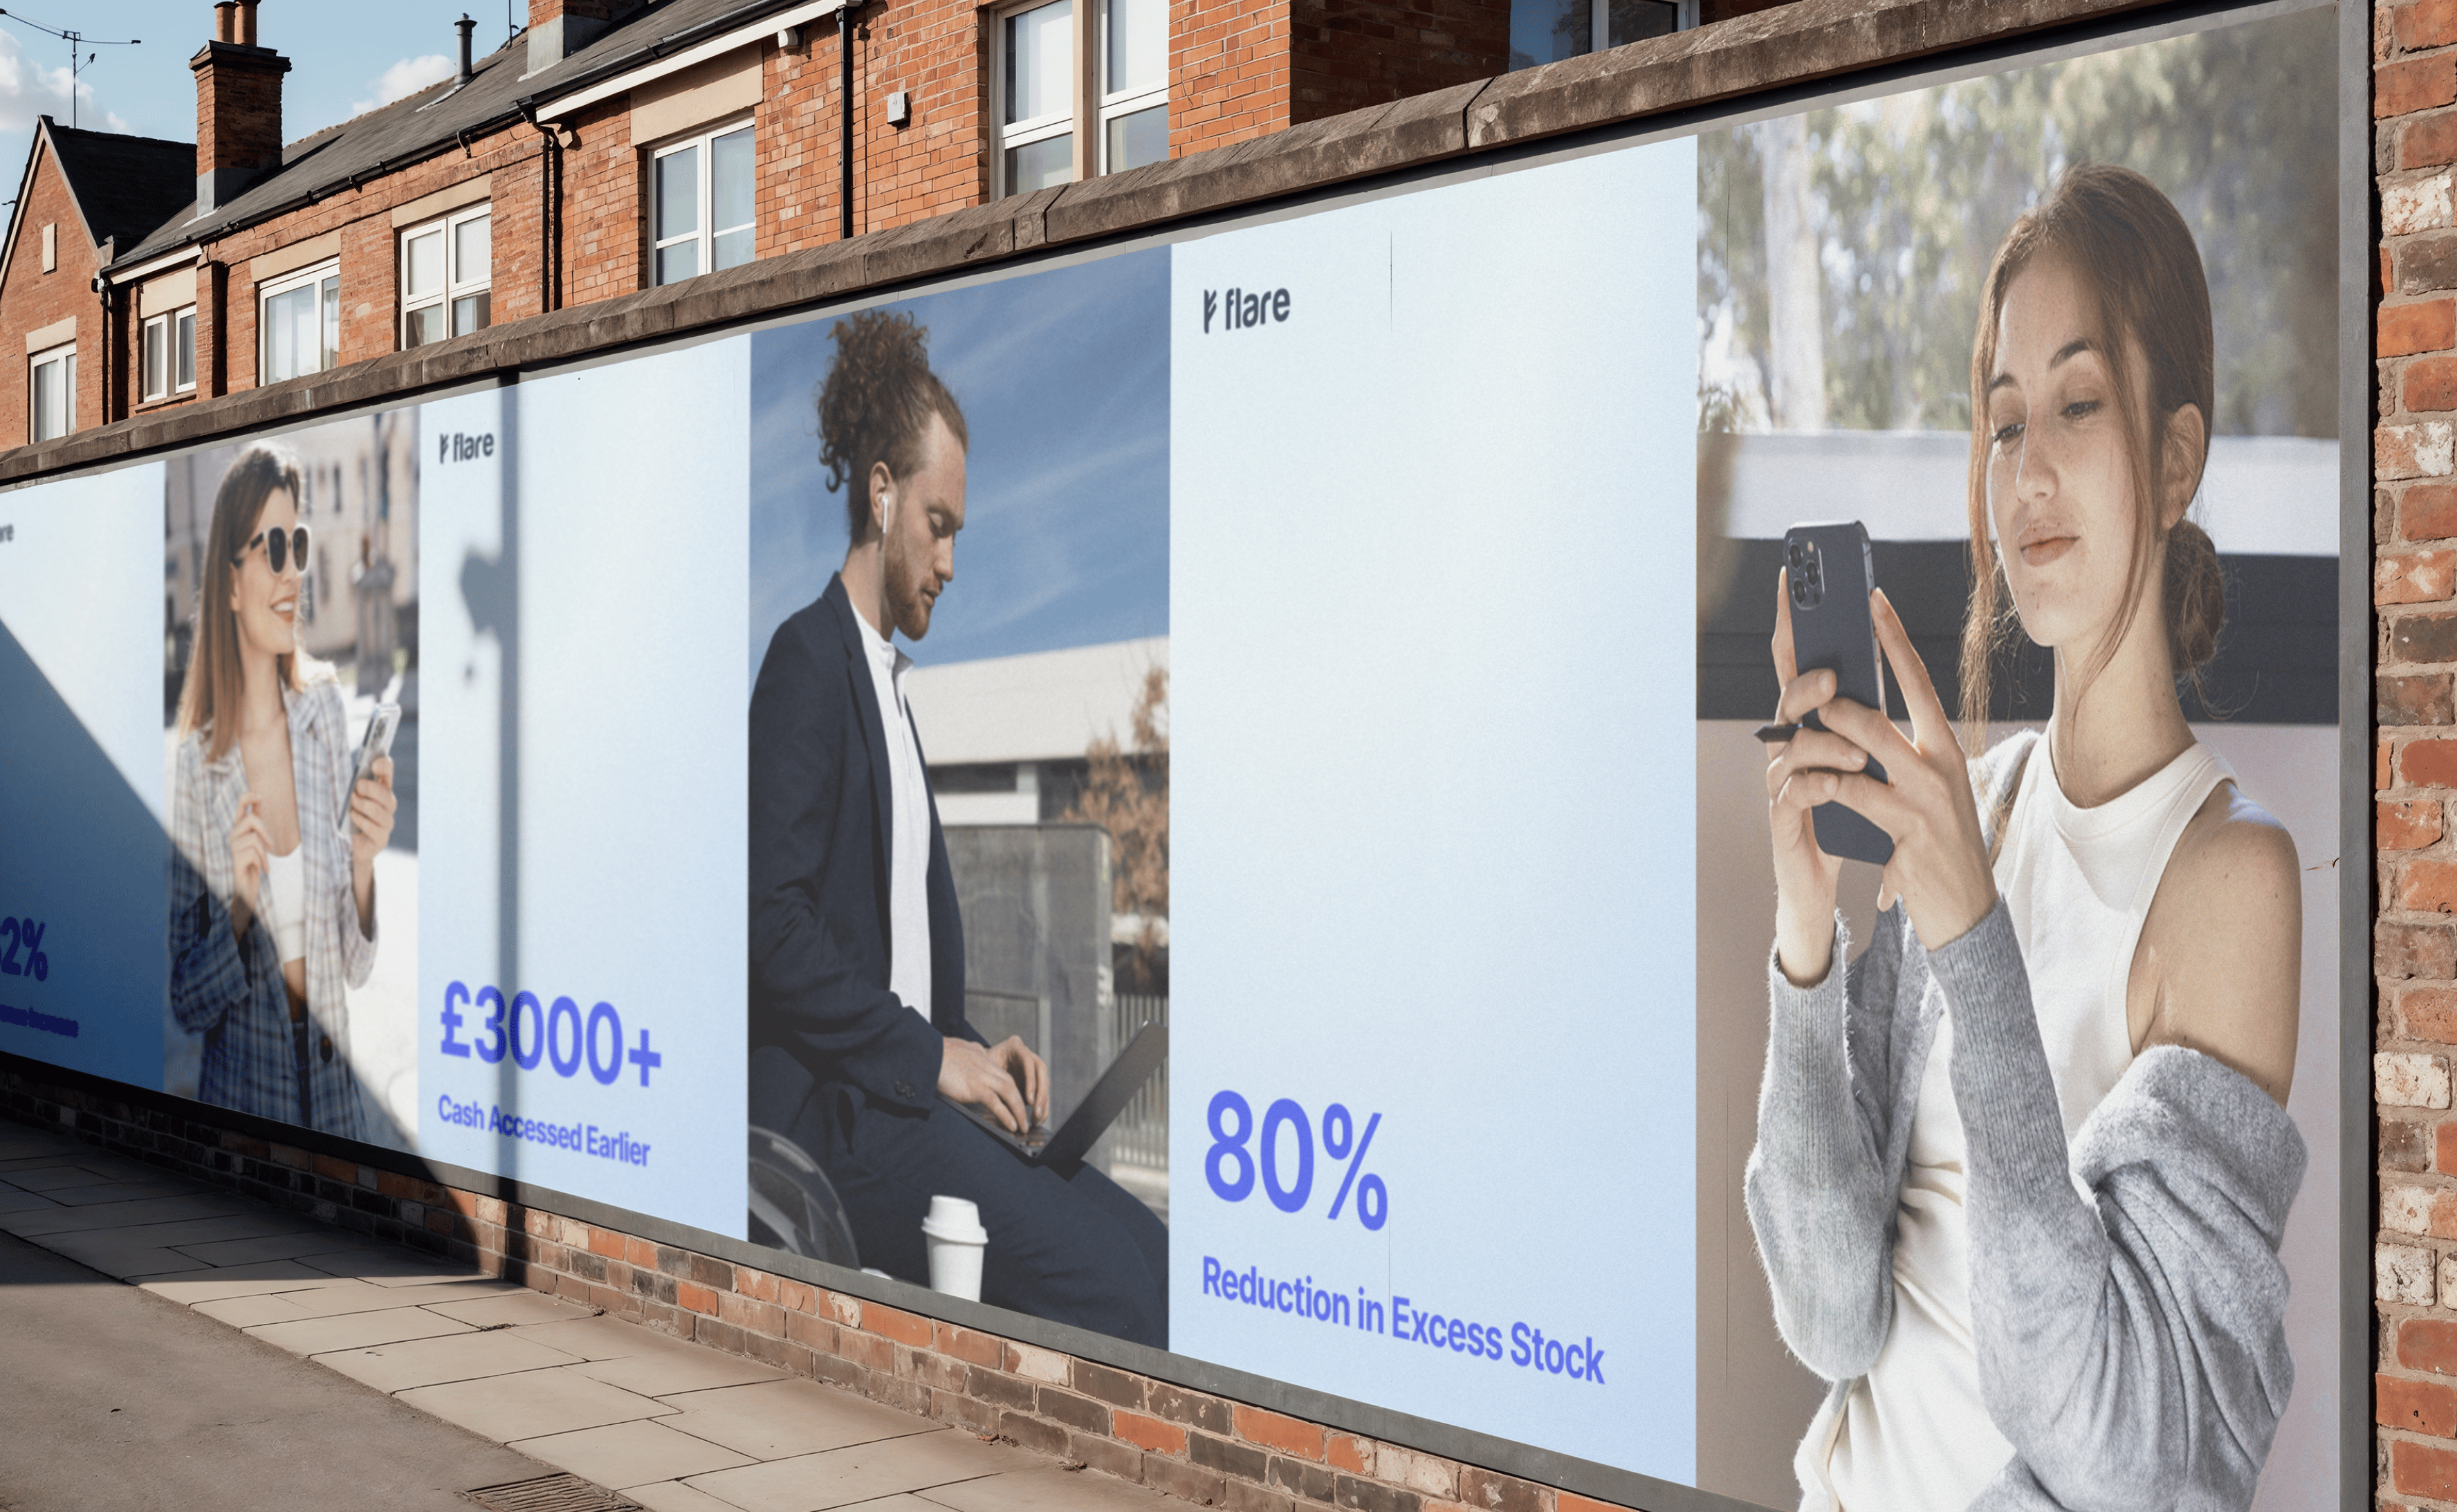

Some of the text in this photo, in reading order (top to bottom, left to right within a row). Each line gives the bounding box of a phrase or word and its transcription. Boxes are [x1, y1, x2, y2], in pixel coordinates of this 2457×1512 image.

[1225, 287, 1291, 331] flare
[453, 432, 495, 463] flare
[0, 916, 48, 981] 2%
[440, 980, 662, 1087] £3000+
[438, 1094, 651, 1168] Cash Accessed Earlier
[1204, 1089, 1388, 1231] 80%
[1203, 1255, 1605, 1385] Reduction in Excess Stock
